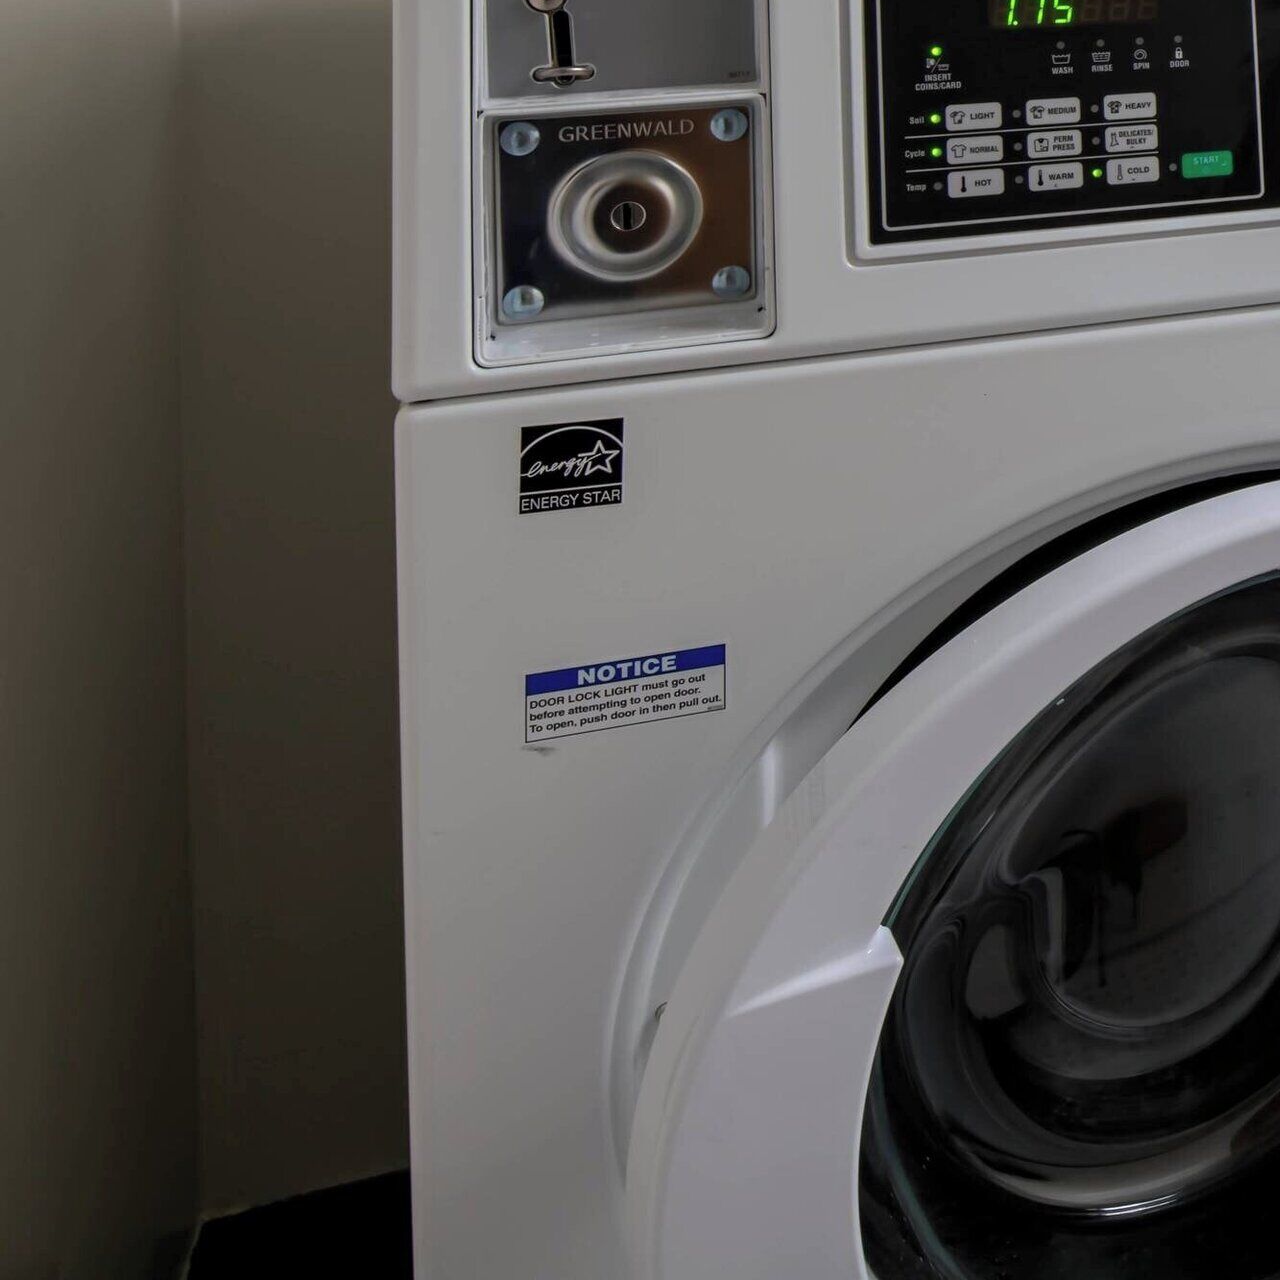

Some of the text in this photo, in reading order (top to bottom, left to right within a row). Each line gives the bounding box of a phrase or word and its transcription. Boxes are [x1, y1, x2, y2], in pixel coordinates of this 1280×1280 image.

[1052, 66, 1073, 74] WASH
[1091, 64, 1113, 72] RINSE
[1133, 62, 1150, 70] SPIN
[925, 73, 952, 82] INSERT
[1048, 106, 1077, 115] MEDIUM
[1125, 102, 1151, 110] HEAVY
[970, 112, 995, 120] LIGHT
[558, 118, 695, 143] GREENWALD
[1054, 135, 1073, 143] PERM
[969, 146, 999, 154] NORMAL
[1052, 143, 1075, 151] PRESS
[905, 150, 925, 159] Cycle
[1193, 155, 1219, 165] START
[1127, 166, 1150, 175] COLD
[1049, 172, 1074, 181] WARM
[906, 183, 926, 192] Temp
[975, 179, 992, 187] HOT
[521, 489, 621, 511] ENERGY STAR
[578, 655, 677, 685] NOTICE
[530, 673, 706, 709] DOOR LOCK LIGHT must go out
[529, 686, 701, 721] before attempting to open door.
[529, 724, 543, 734] To
[546, 719, 577, 732] open,
[580, 714, 608, 727] push
[611, 708, 636, 720] door
[639, 706, 649, 715] in
[652, 702, 676, 713] then
[679, 698, 699, 710] pull
[702, 694, 721, 705] out.
